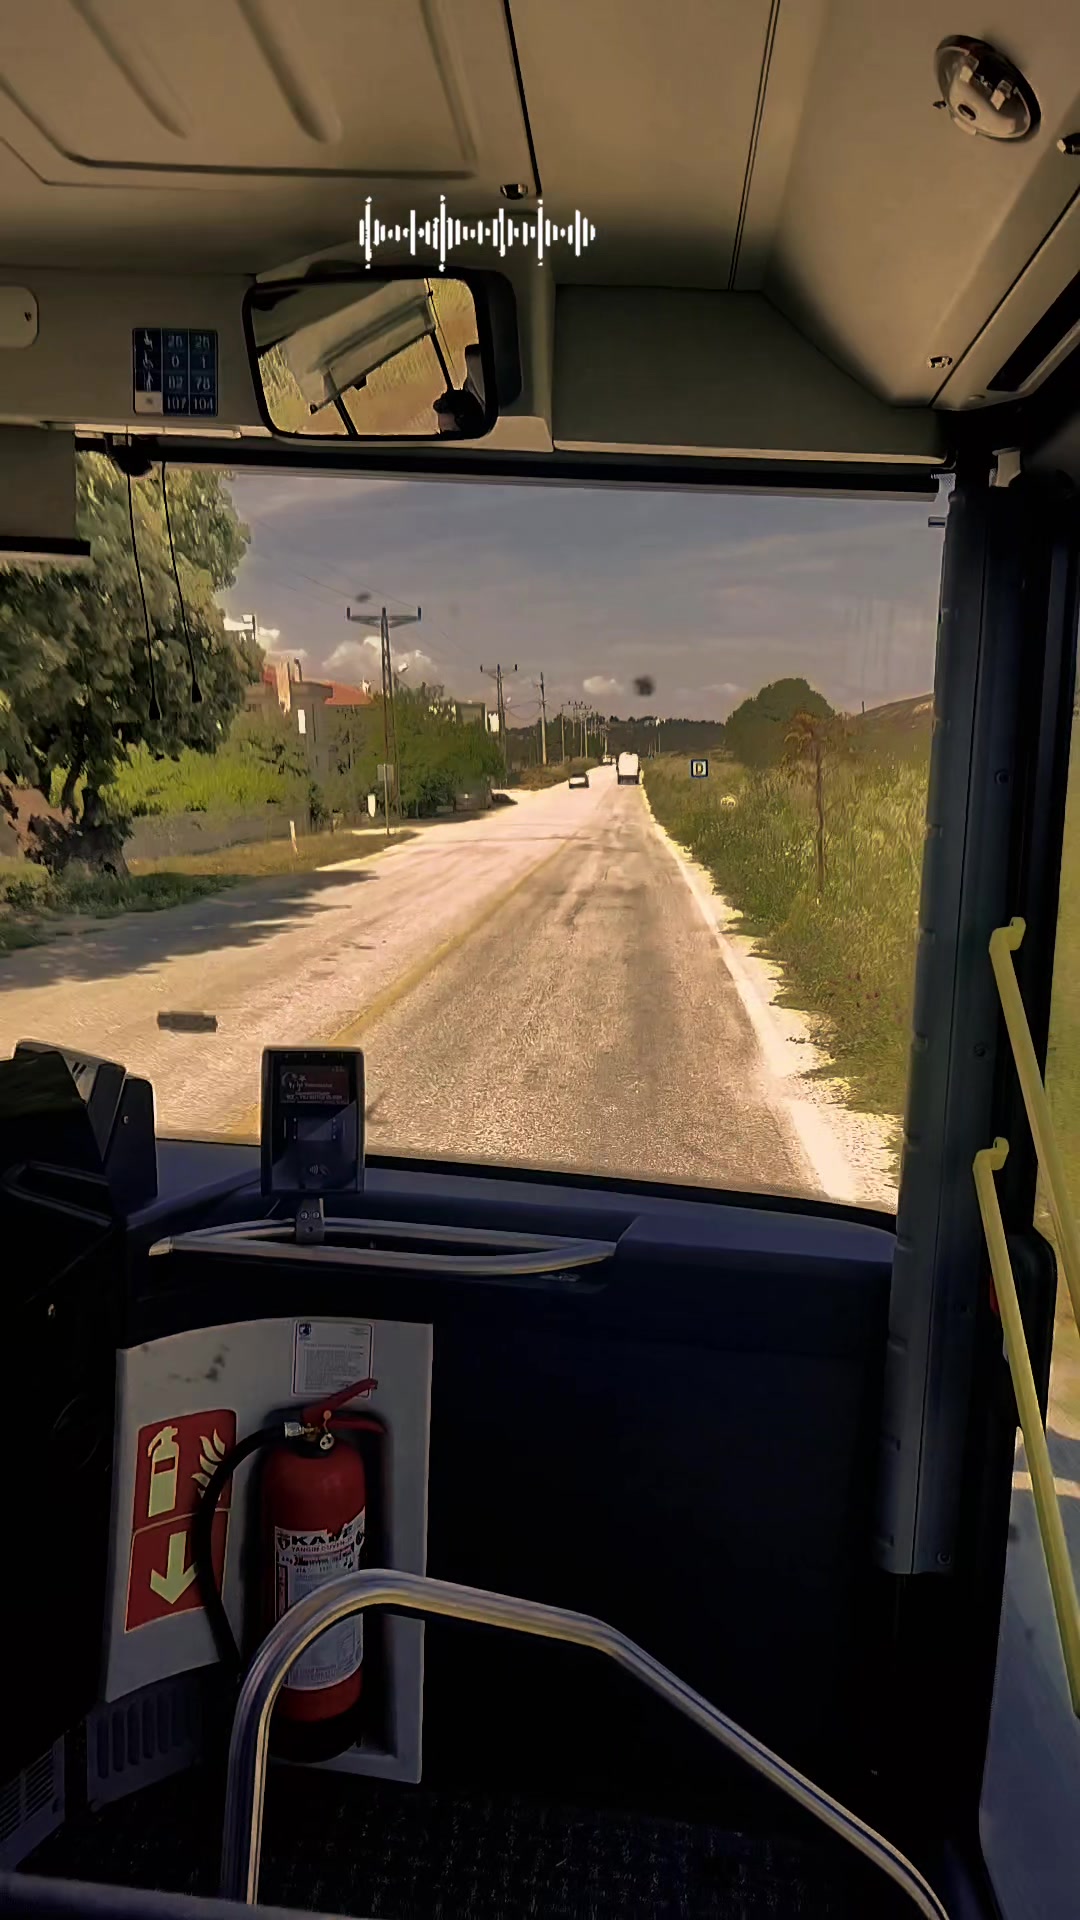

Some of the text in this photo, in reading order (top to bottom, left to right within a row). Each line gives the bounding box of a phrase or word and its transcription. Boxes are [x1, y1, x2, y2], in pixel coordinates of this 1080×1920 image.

[171, 354, 180, 368] 0
[201, 354, 206, 369] 1
[695, 763, 704, 775] D
